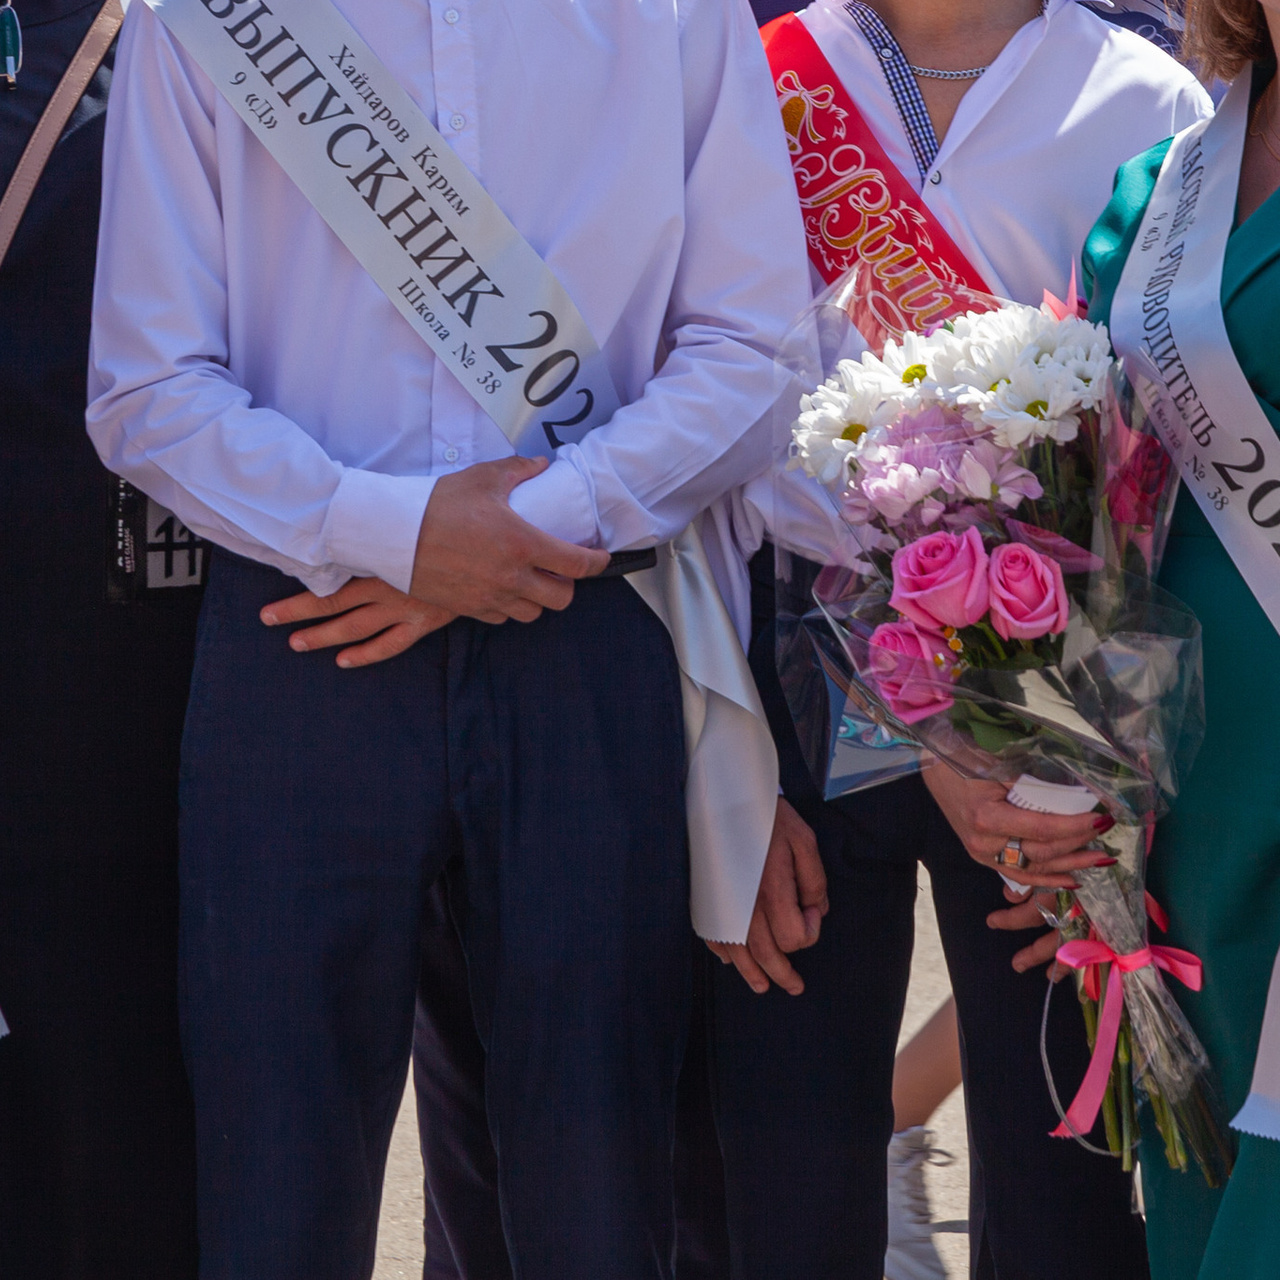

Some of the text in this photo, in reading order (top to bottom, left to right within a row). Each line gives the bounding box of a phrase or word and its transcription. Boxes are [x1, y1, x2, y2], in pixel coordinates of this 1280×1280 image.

[229, 71, 278, 129] 9 «Д»
[328, 43, 471, 218] Хайдаров Карим
[398, 276, 503, 396] Школа № 38
[485, 309, 597, 451] 202
[1142, 240, 1217, 448] РУКОВОДИТЕЛЬ
[1184, 454, 1206, 482] №
[1207, 486, 1230, 511] 38
